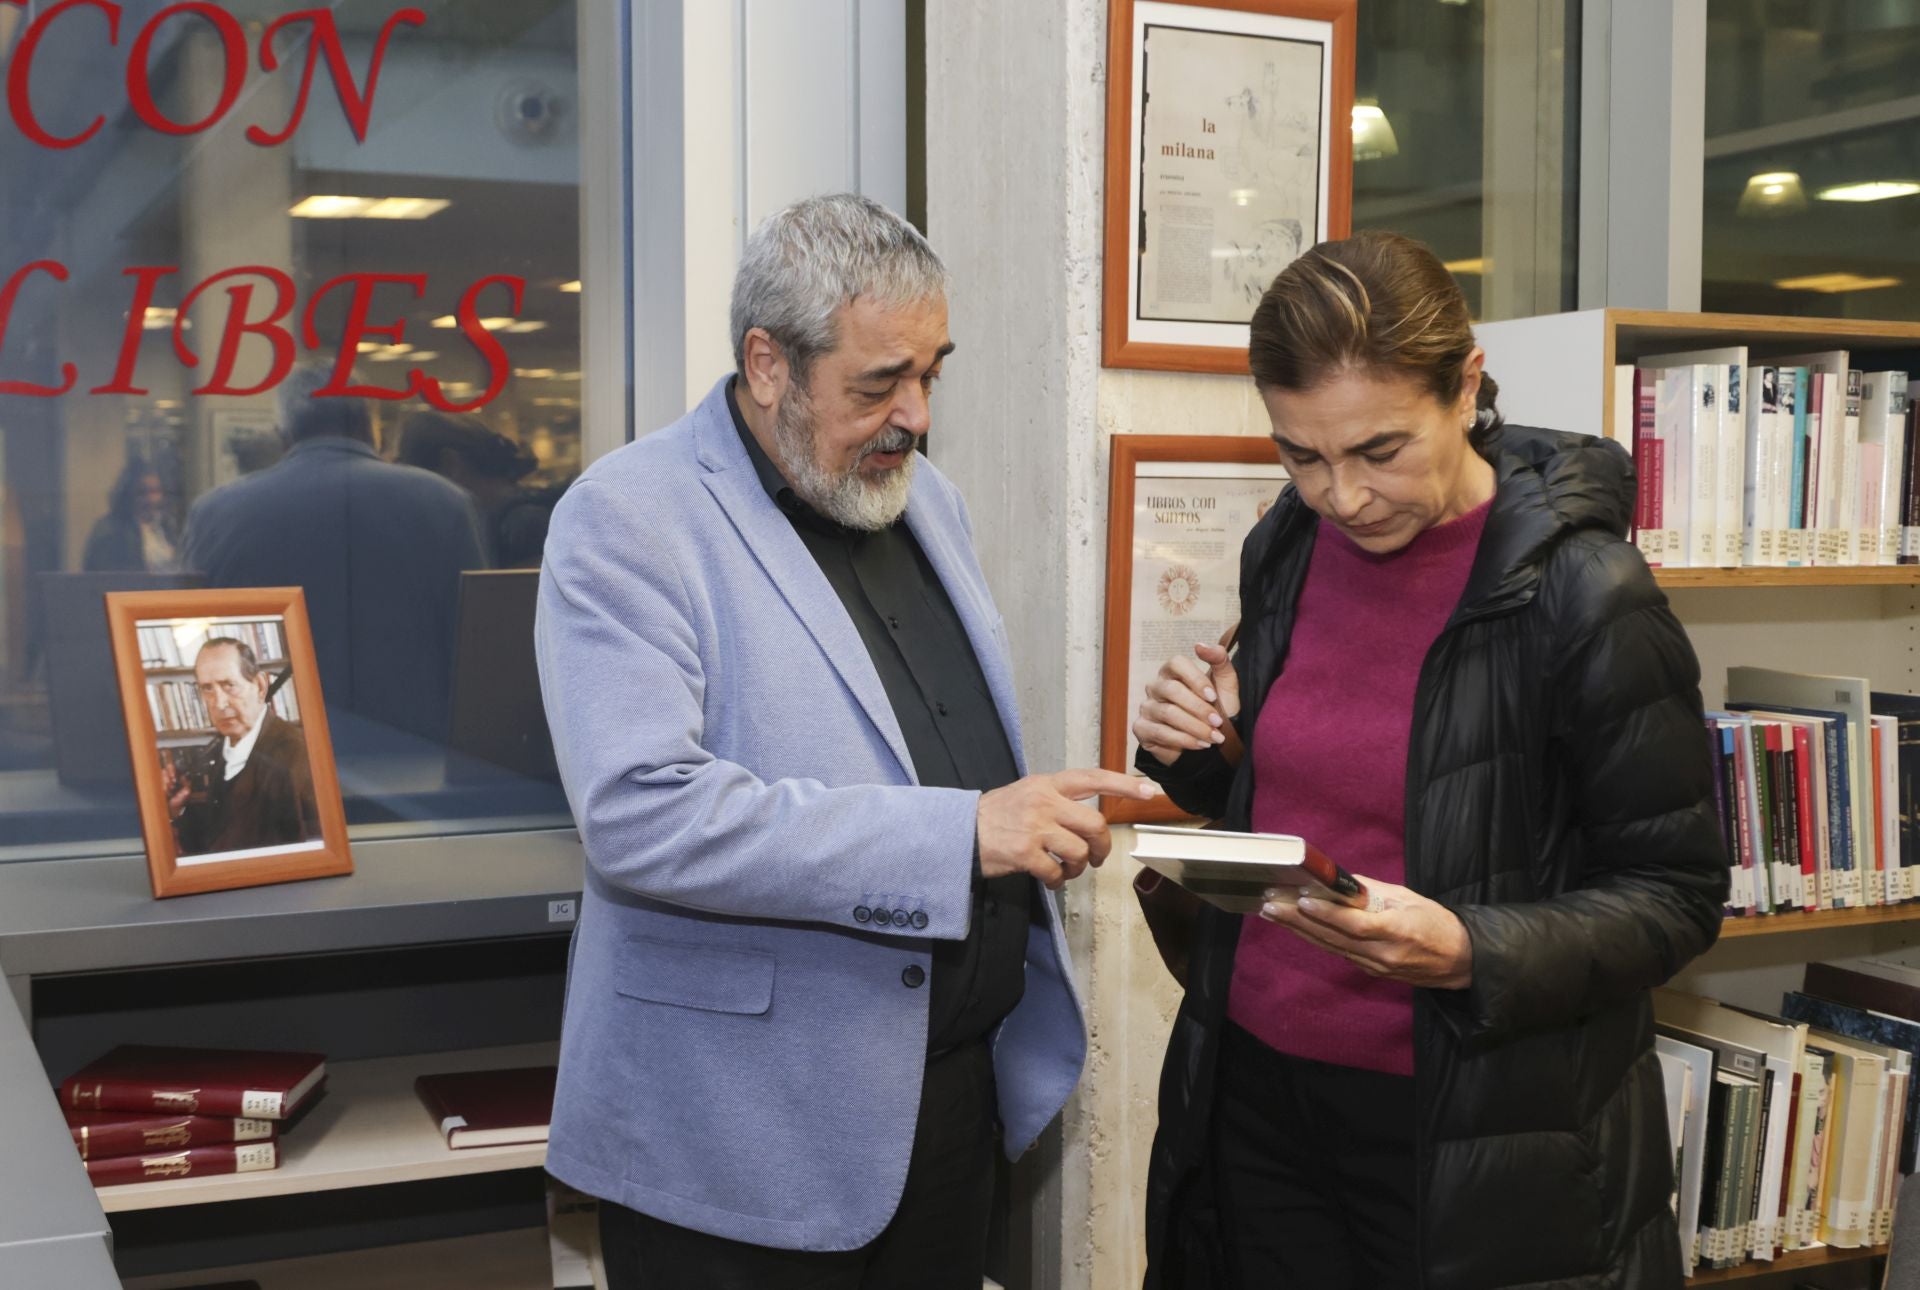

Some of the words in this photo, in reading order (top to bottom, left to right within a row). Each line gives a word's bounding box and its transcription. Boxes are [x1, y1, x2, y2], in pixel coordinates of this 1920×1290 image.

[0, 0, 427, 149] CON
[1202, 118, 1216, 134] la
[1161, 142, 1216, 160] milana
[555, 903, 569, 914] JG
